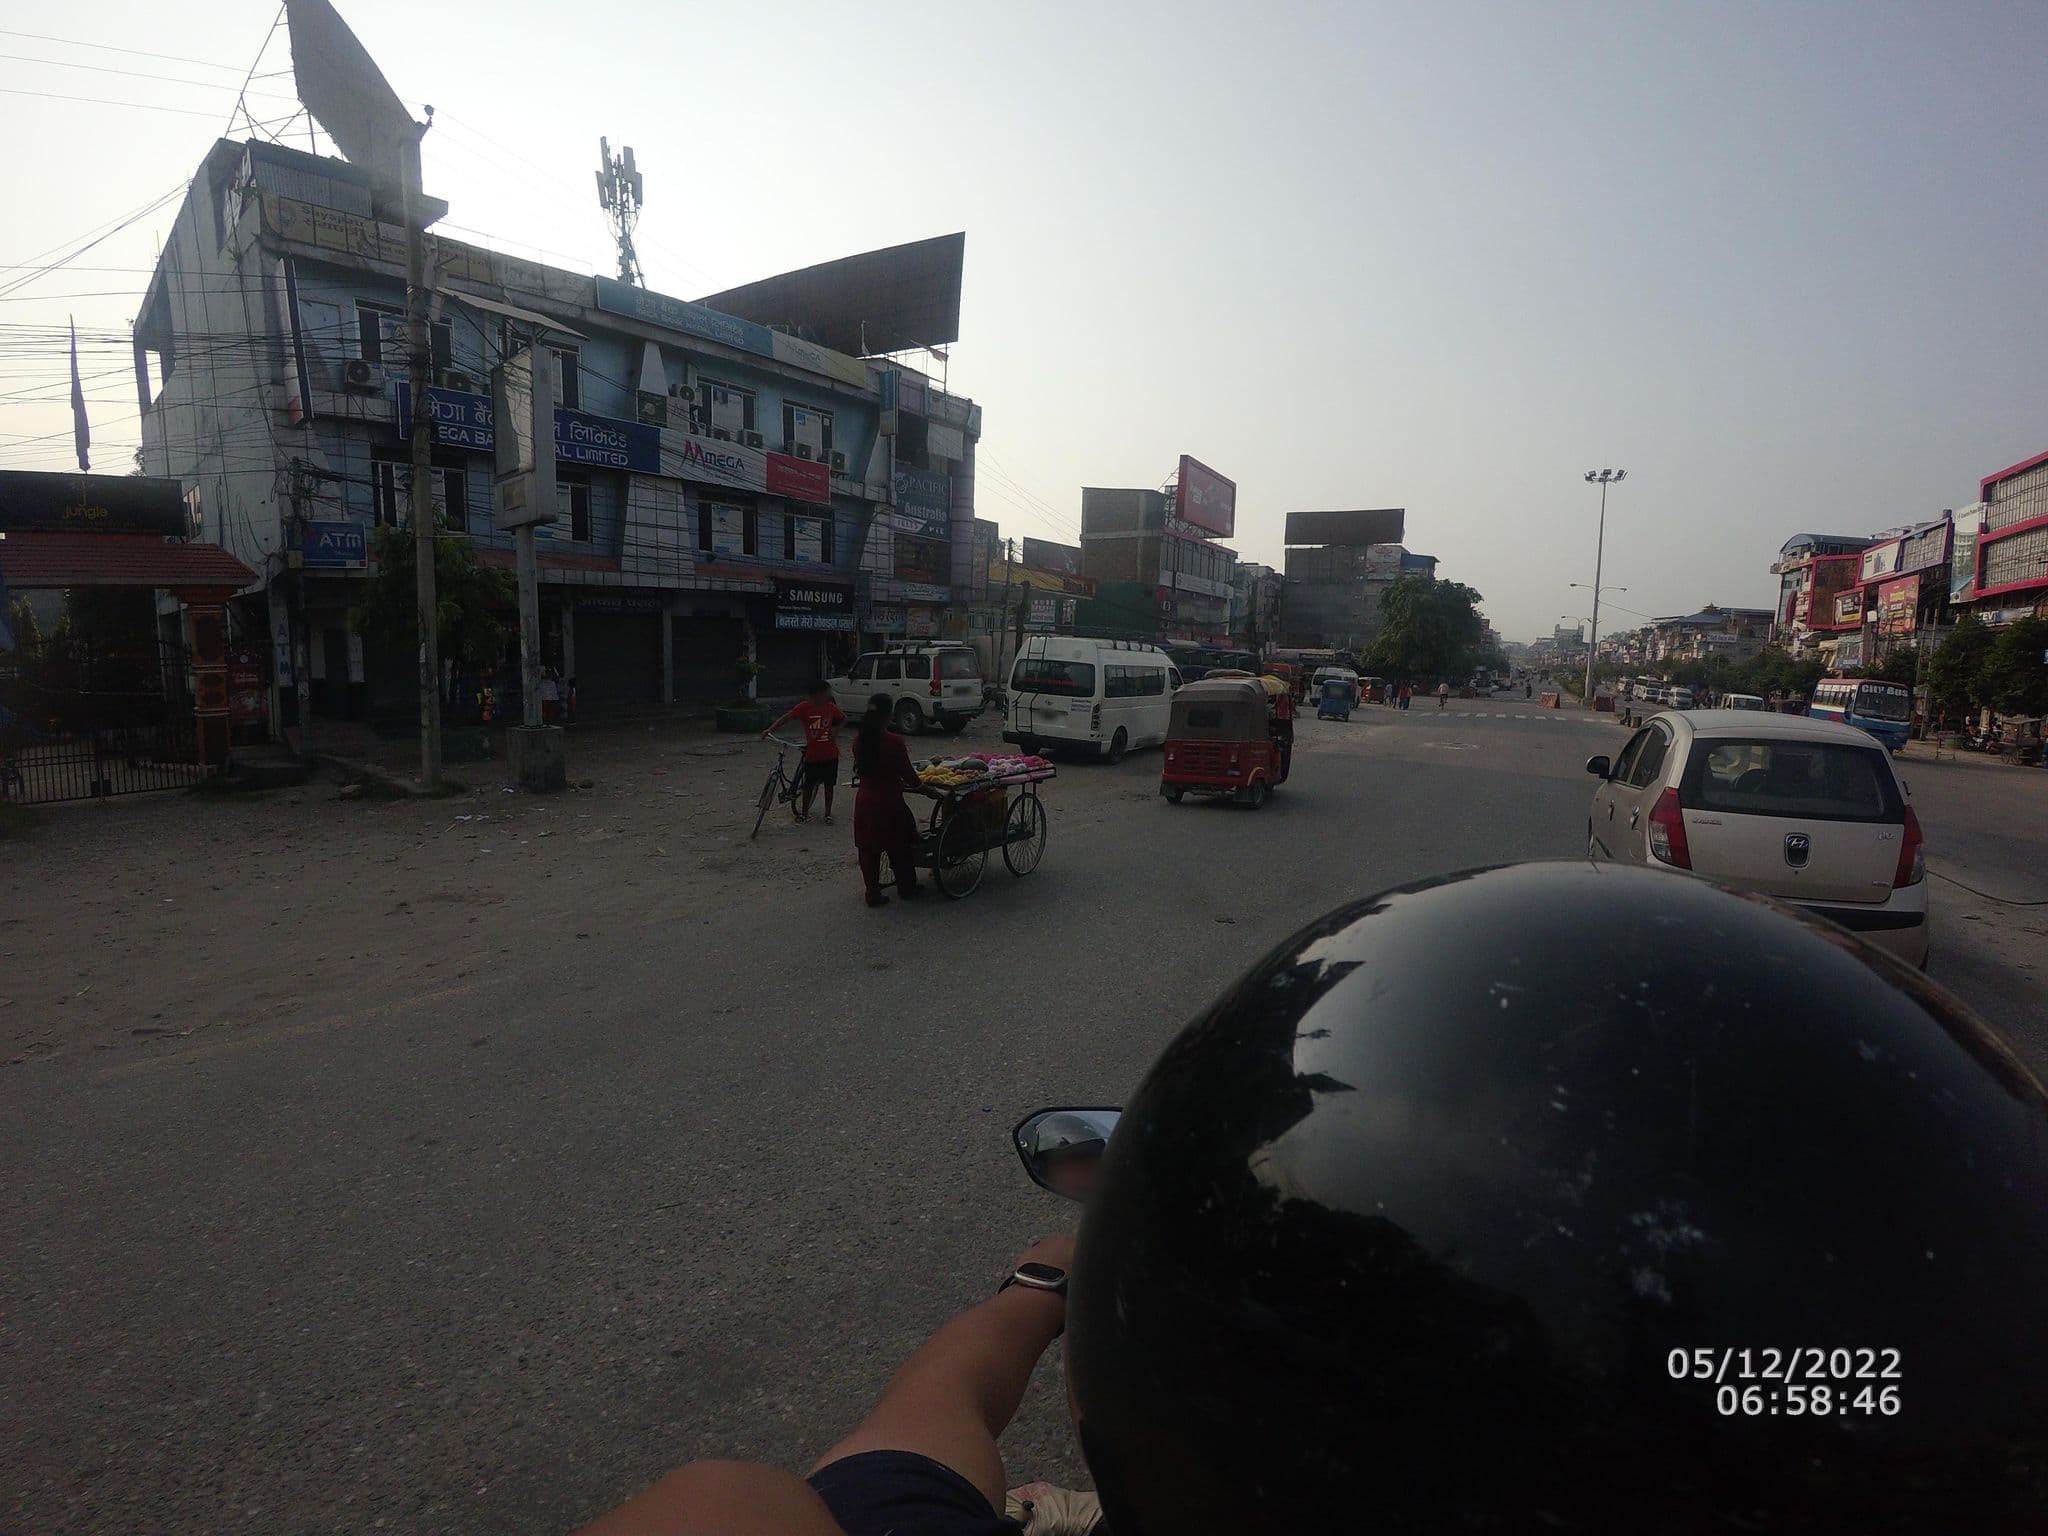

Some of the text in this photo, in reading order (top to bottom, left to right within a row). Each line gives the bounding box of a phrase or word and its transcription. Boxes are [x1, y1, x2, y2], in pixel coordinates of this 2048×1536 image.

[473, 400, 493, 426] बैं
[438, 425, 470, 443] EGA
[576, 446, 629, 466] LIMITED
[319, 532, 361, 548] ATM
[789, 588, 844, 604] SAMSUNG
